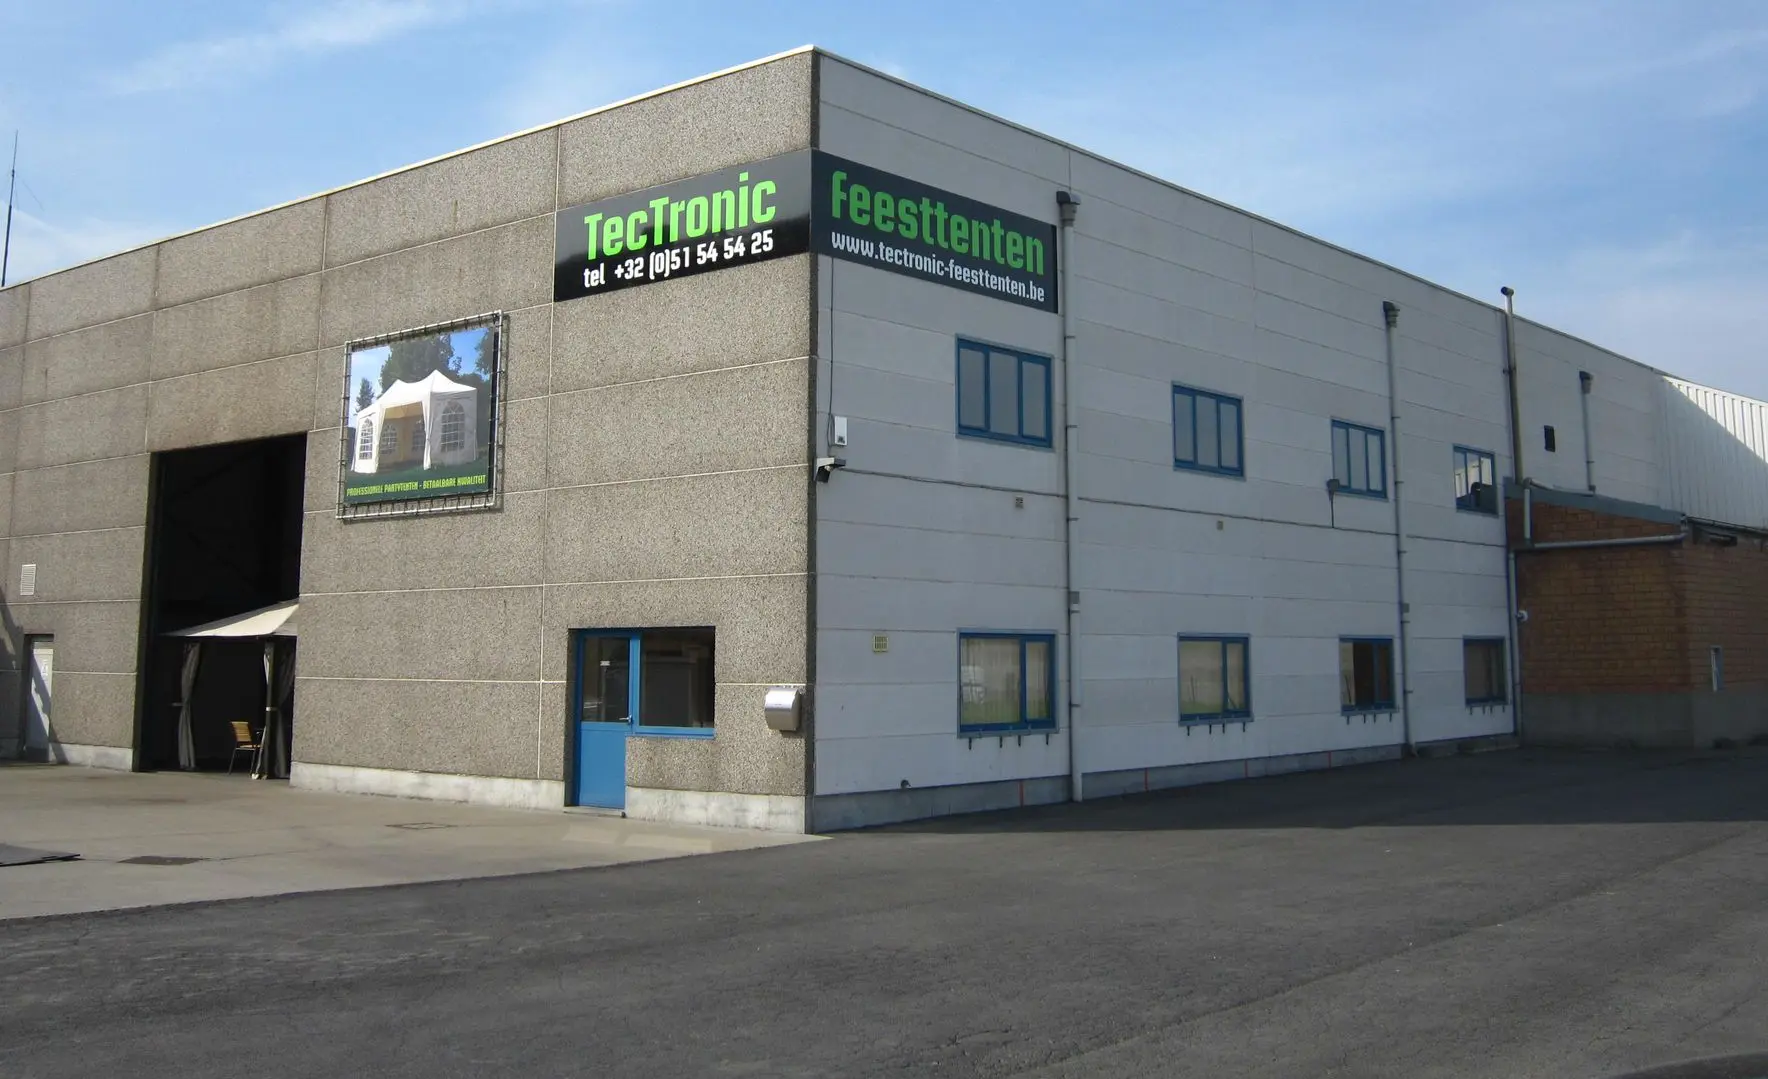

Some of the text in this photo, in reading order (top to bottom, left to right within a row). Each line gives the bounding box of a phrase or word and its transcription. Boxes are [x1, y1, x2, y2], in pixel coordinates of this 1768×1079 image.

[584, 172, 777, 261] TecTronic
[584, 229, 774, 288] tel +32 (0)51 54 54 25
[831, 231, 1045, 302] www.tectronic-feesttenten.be
[423, 478, 456, 489] BETAALBARE
[457, 474, 486, 486] KWALITEIT
